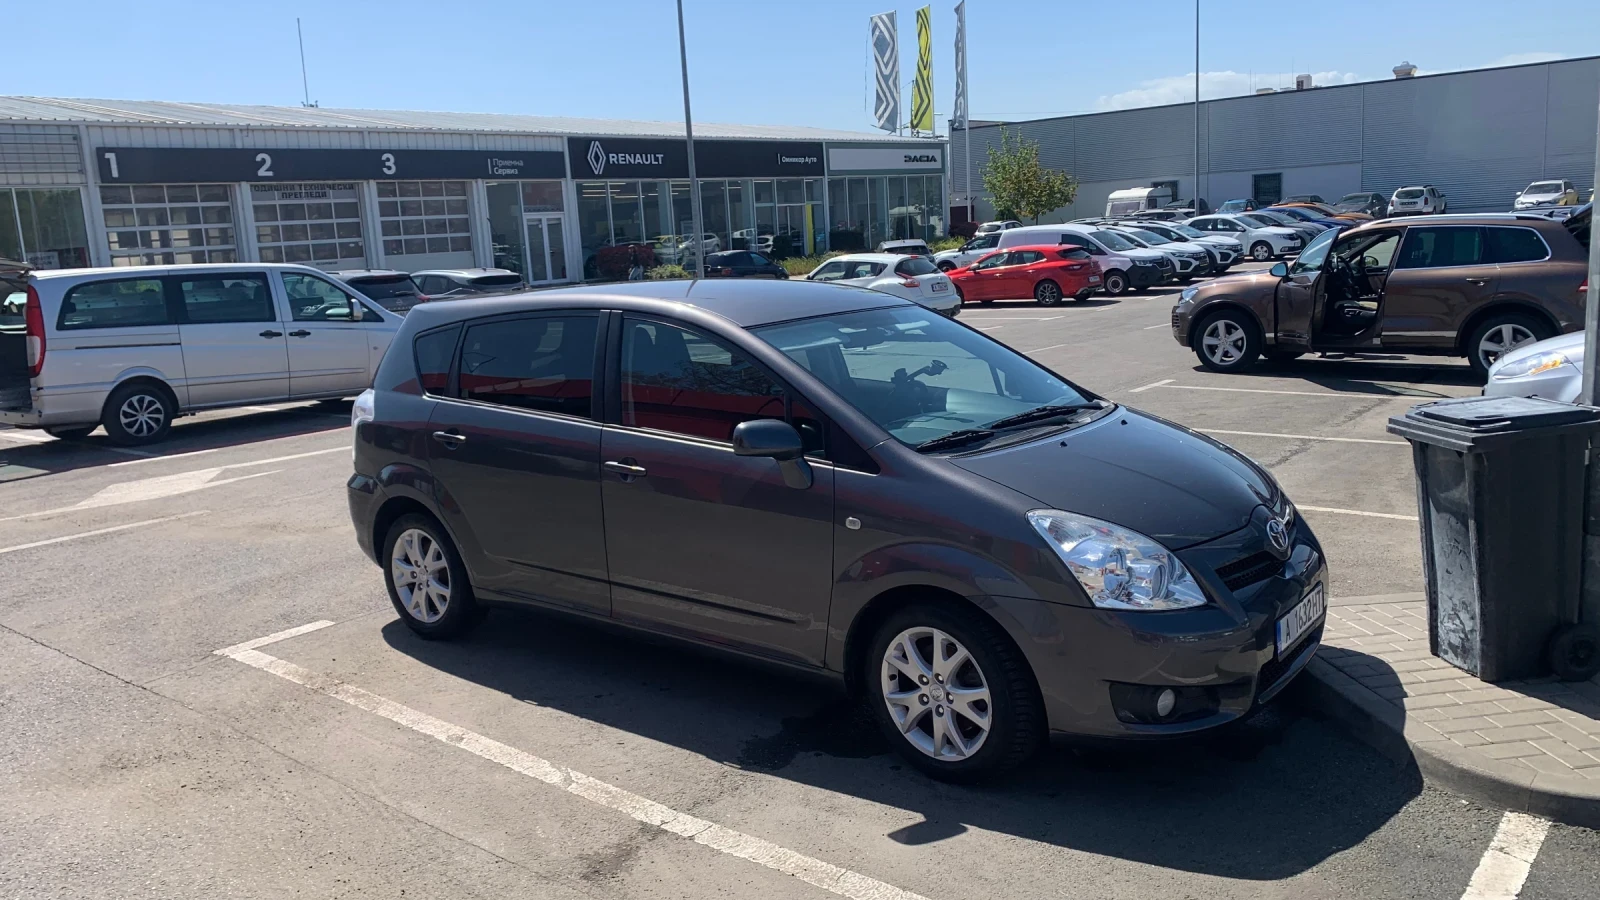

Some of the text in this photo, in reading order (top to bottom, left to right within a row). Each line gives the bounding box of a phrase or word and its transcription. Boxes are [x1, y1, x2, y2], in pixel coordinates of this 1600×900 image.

[608, 153, 664, 165] RENAULT
[903, 154, 938, 163] DACIA
[104, 152, 119, 178] 1
[255, 153, 274, 176] 2
[381, 153, 397, 175] 3
[493, 167, 519, 176] Сервиз
[299, 183, 354, 191] ТЕХНИЧЕСКИ
[281, 191, 327, 199] ПРЕГЛЕДИ
